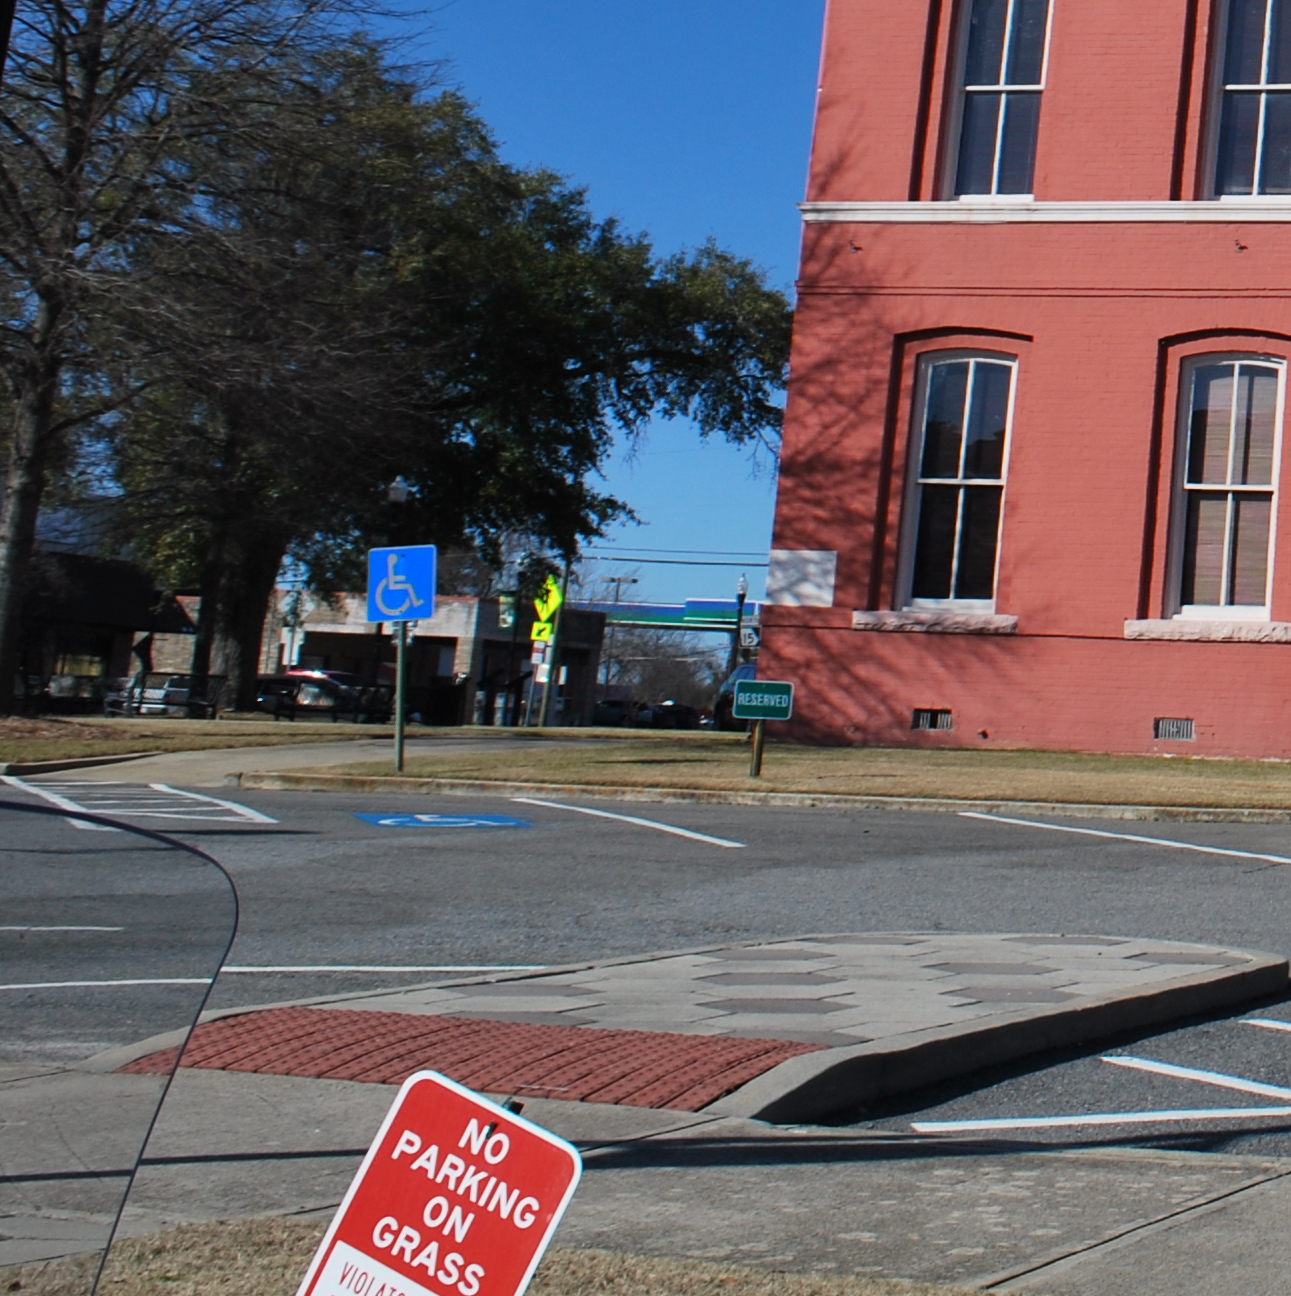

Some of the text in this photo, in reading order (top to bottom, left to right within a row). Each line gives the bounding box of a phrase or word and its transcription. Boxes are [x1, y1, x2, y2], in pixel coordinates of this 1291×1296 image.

[742, 632, 754, 644] 15
[738, 692, 789, 707] RESERVED
[458, 1117, 510, 1165] NO
[391, 1129, 540, 1230] PARKING
[423, 1195, 476, 1244] ON
[338, 1261, 406, 1296] VIOLA
[372, 1215, 485, 1296] GRASS
